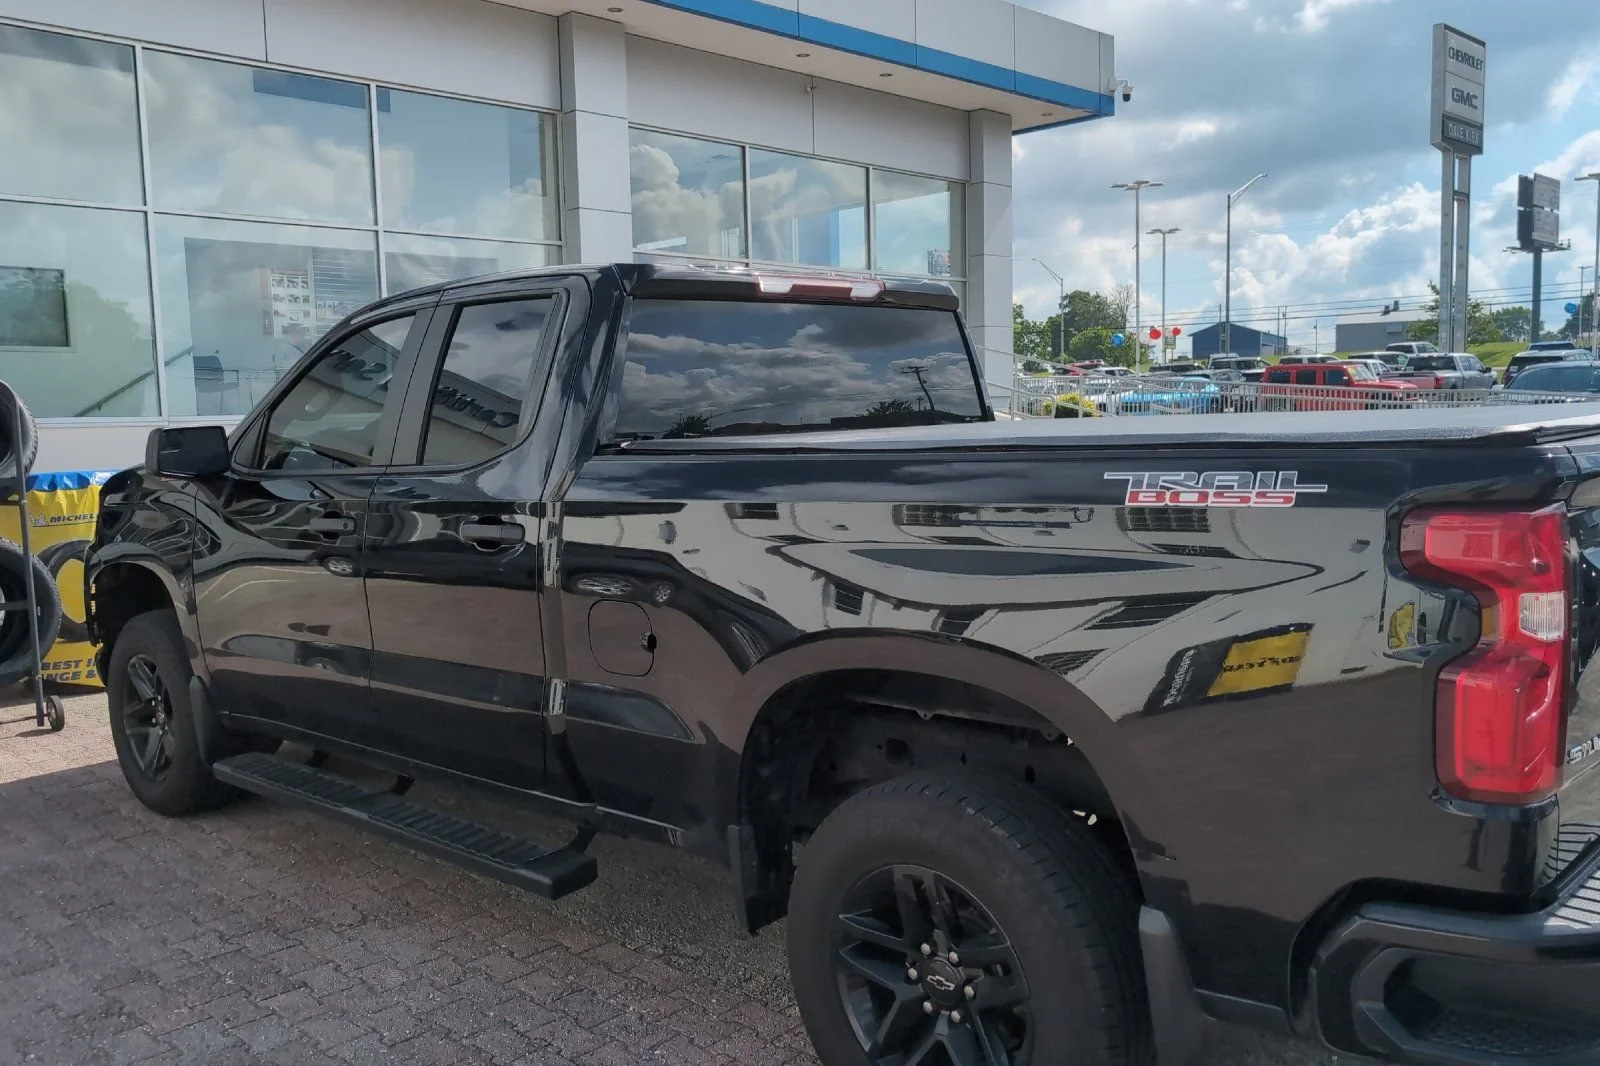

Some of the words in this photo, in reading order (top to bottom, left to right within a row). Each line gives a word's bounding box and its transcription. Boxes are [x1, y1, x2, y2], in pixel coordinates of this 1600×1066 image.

[1448, 47, 1483, 71] CHEVROLET
[1451, 87, 1478, 110] GMC
[1104, 470, 1328, 492] TRAIL
[1126, 489, 1297, 507] BOSS
[41, 659, 83, 671] BEST
